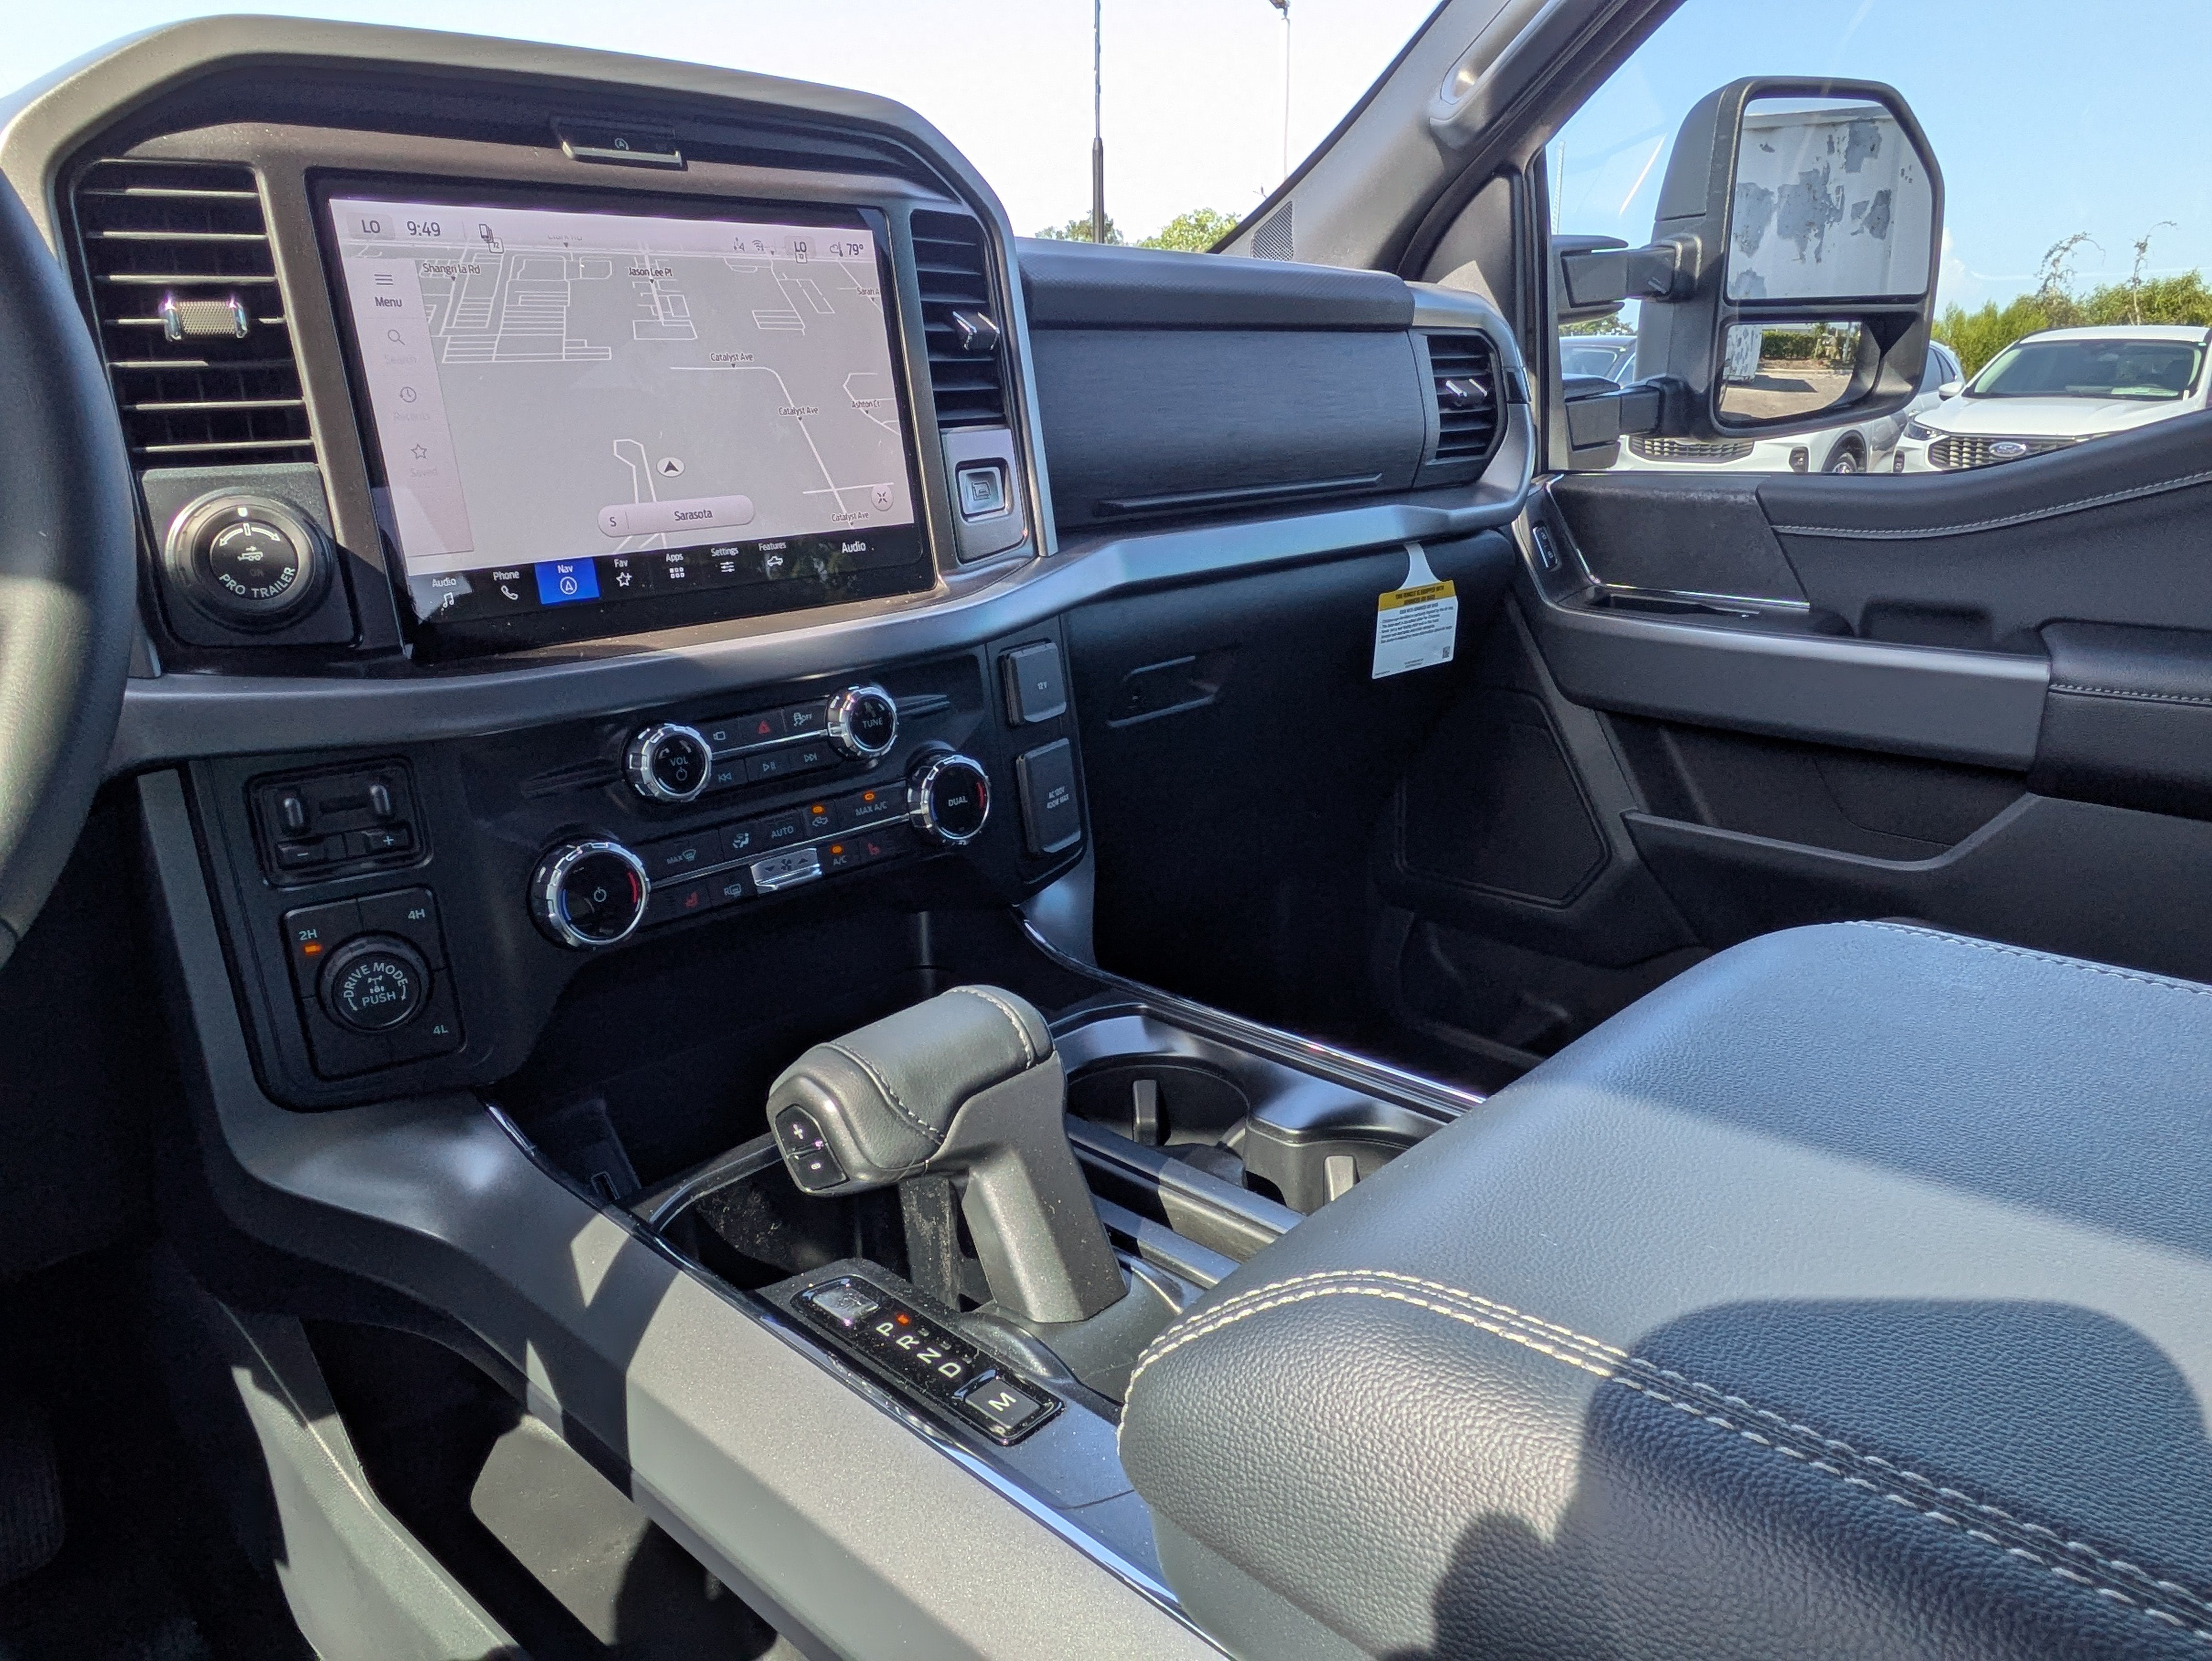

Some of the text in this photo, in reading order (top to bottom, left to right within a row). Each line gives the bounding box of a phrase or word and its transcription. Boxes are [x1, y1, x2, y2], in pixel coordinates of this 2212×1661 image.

[362, 220, 381, 233] LO
[407, 221, 441, 237] 9:49
[794, 241, 807, 253] LO
[423, 264, 457, 275] Shangri
[468, 265, 480, 274] Rd
[629, 267, 673, 277] Jason Lee Pl
[375, 296, 402, 307] Menu
[710, 353, 753, 362] Catalyst Ave
[779, 407, 806, 416] Catalyst
[674, 508, 713, 522] Sarasota
[831, 511, 869, 523] Catalyst Ave
[609, 516, 617, 527] S
[711, 547, 739, 558] Settings
[758, 542, 787, 552] Features
[841, 541, 866, 554] Audio
[614, 559, 628, 568] Fav
[666, 553, 684, 563] Apps
[557, 564, 574, 574] Nav
[493, 570, 520, 581] Phone
[219, 567, 296, 598] PRO TRAILER
[432, 577, 456, 588] Audio
[862, 718, 884, 728] TUNE
[670, 757, 688, 766] VOL
[948, 795, 968, 807] DUAL
[855, 806, 873, 816] MAX
[771, 825, 794, 839] AUTO
[408, 908, 426, 920] 4H
[299, 929, 318, 941] 2H
[343, 962, 409, 998] DRIVE MODE
[362, 991, 396, 1007] PUSH
[432, 1025, 449, 1035] 4L
[875, 1322, 962, 1378] P R N D
[988, 1392, 1017, 1412] M
